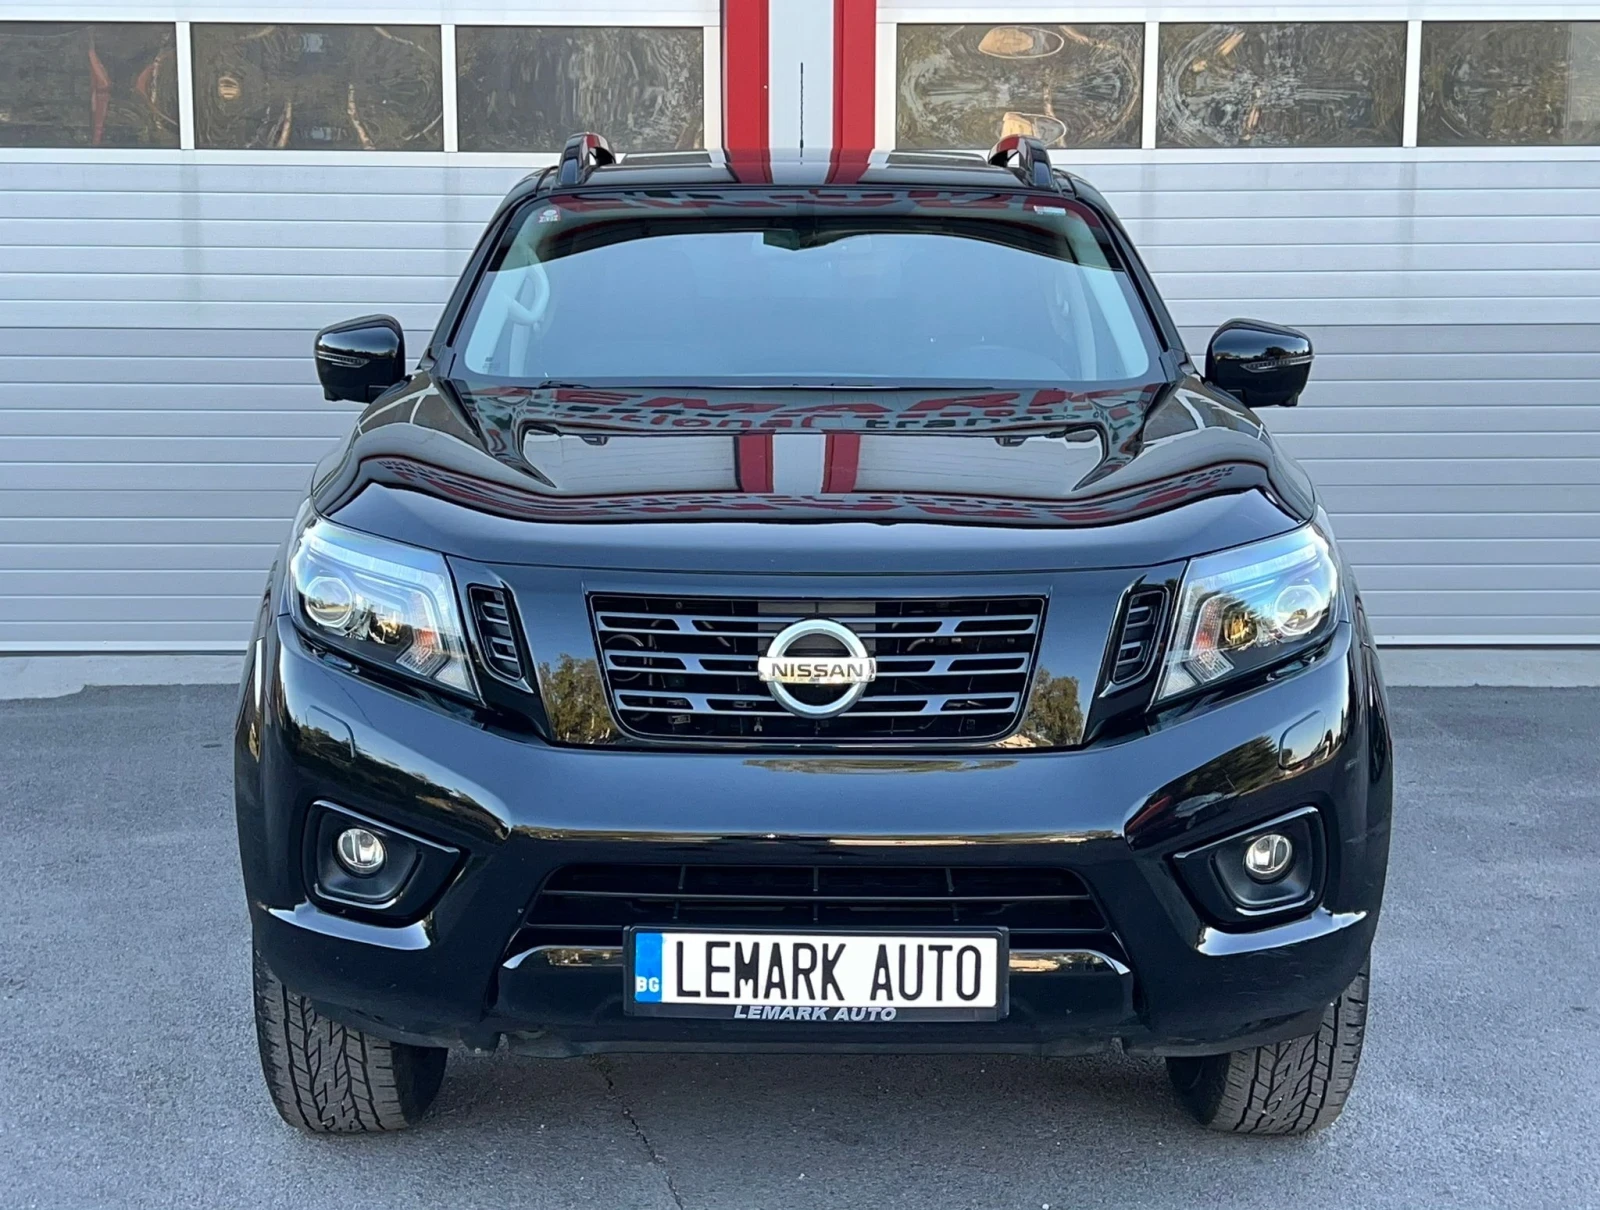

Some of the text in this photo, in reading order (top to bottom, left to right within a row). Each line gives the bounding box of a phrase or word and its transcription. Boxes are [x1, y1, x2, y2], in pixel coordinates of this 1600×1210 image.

[771, 663, 863, 678] NISSAN
[676, 940, 982, 1002] LEMARK AUTO
[635, 976, 660, 993] BG
[734, 1004, 897, 1022] LEMARK AUTO
